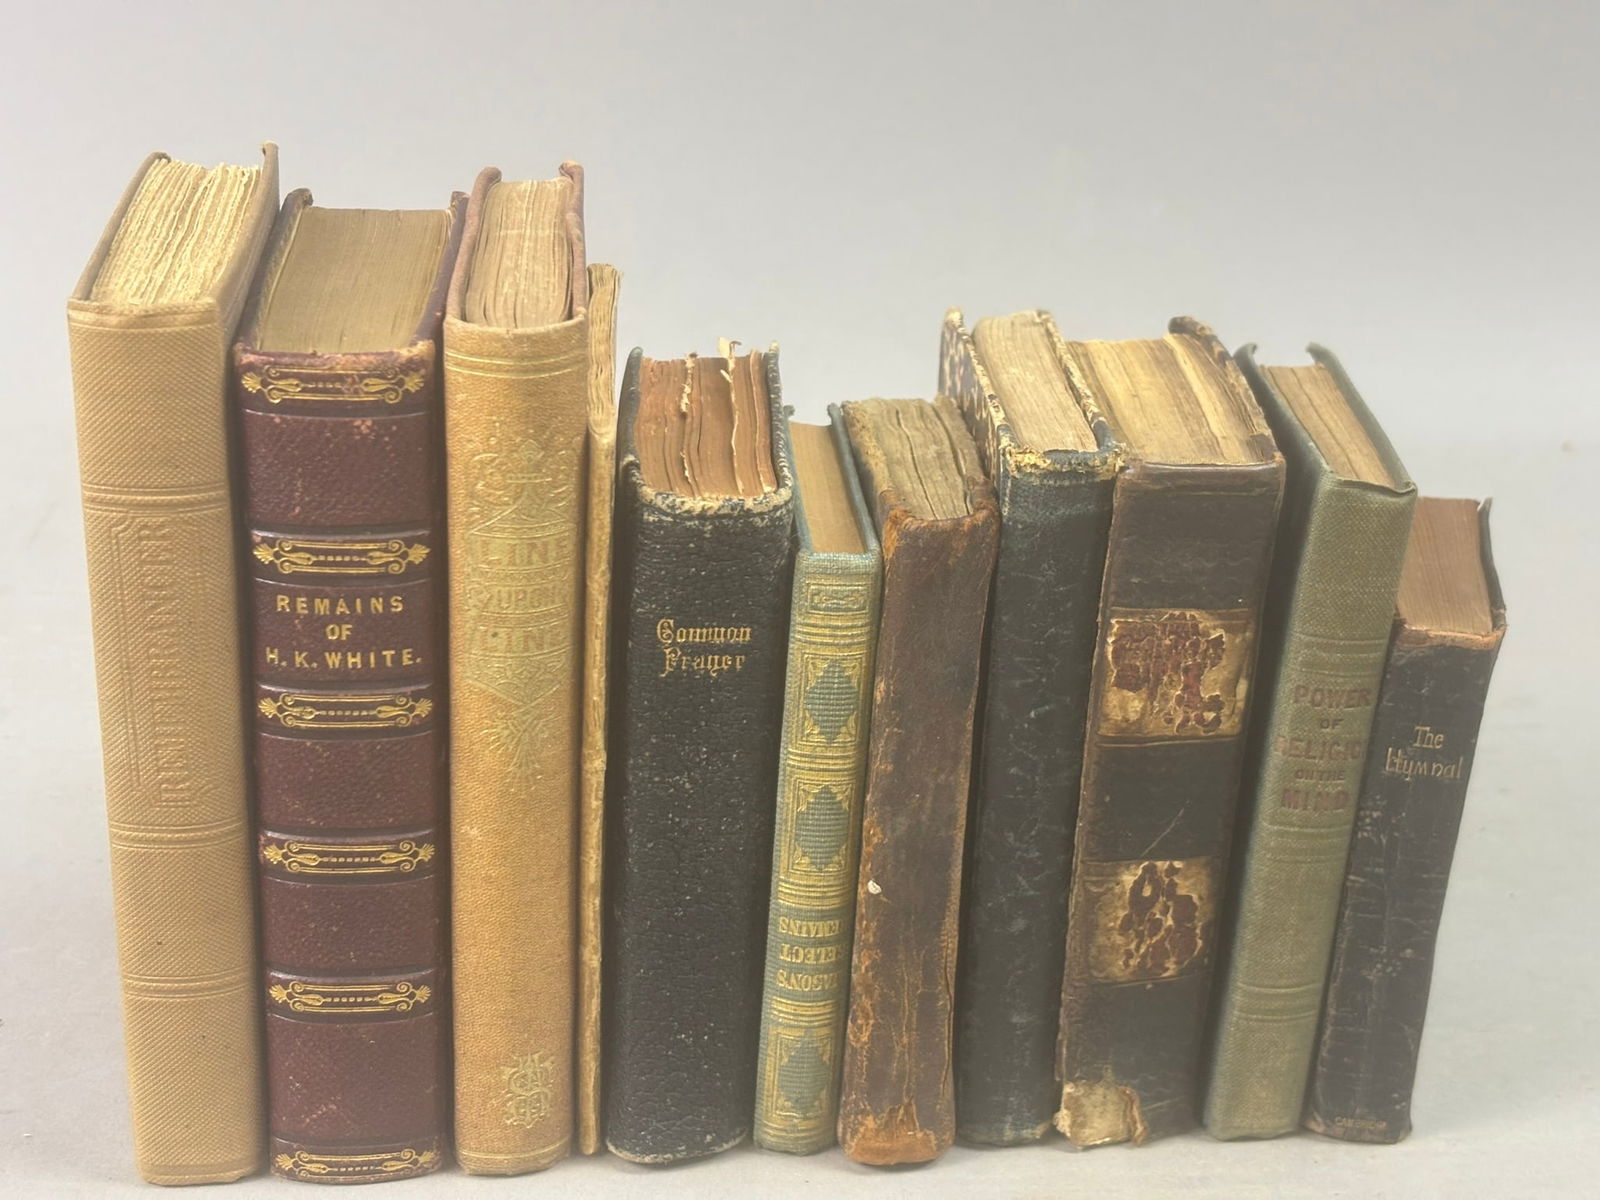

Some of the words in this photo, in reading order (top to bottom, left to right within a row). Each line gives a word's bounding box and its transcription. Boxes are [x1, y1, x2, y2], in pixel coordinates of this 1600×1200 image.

[276, 594, 404, 615] REMAINS
[325, 624, 353, 640] OF
[656, 618, 752, 644] Common
[266, 647, 287, 667] H.
[294, 650, 318, 669] K.
[325, 648, 422, 669] WHITE.
[660, 646, 746, 677] Prayer
[1293, 685, 1372, 708] POWER
[1319, 717, 1345, 730] OF
[1412, 726, 1445, 748] The
[1385, 747, 1463, 781] Hymnal
[1294, 769, 1313, 781] ON
[1317, 769, 1346, 782] THE
[1281, 788, 1350, 811] MIND
